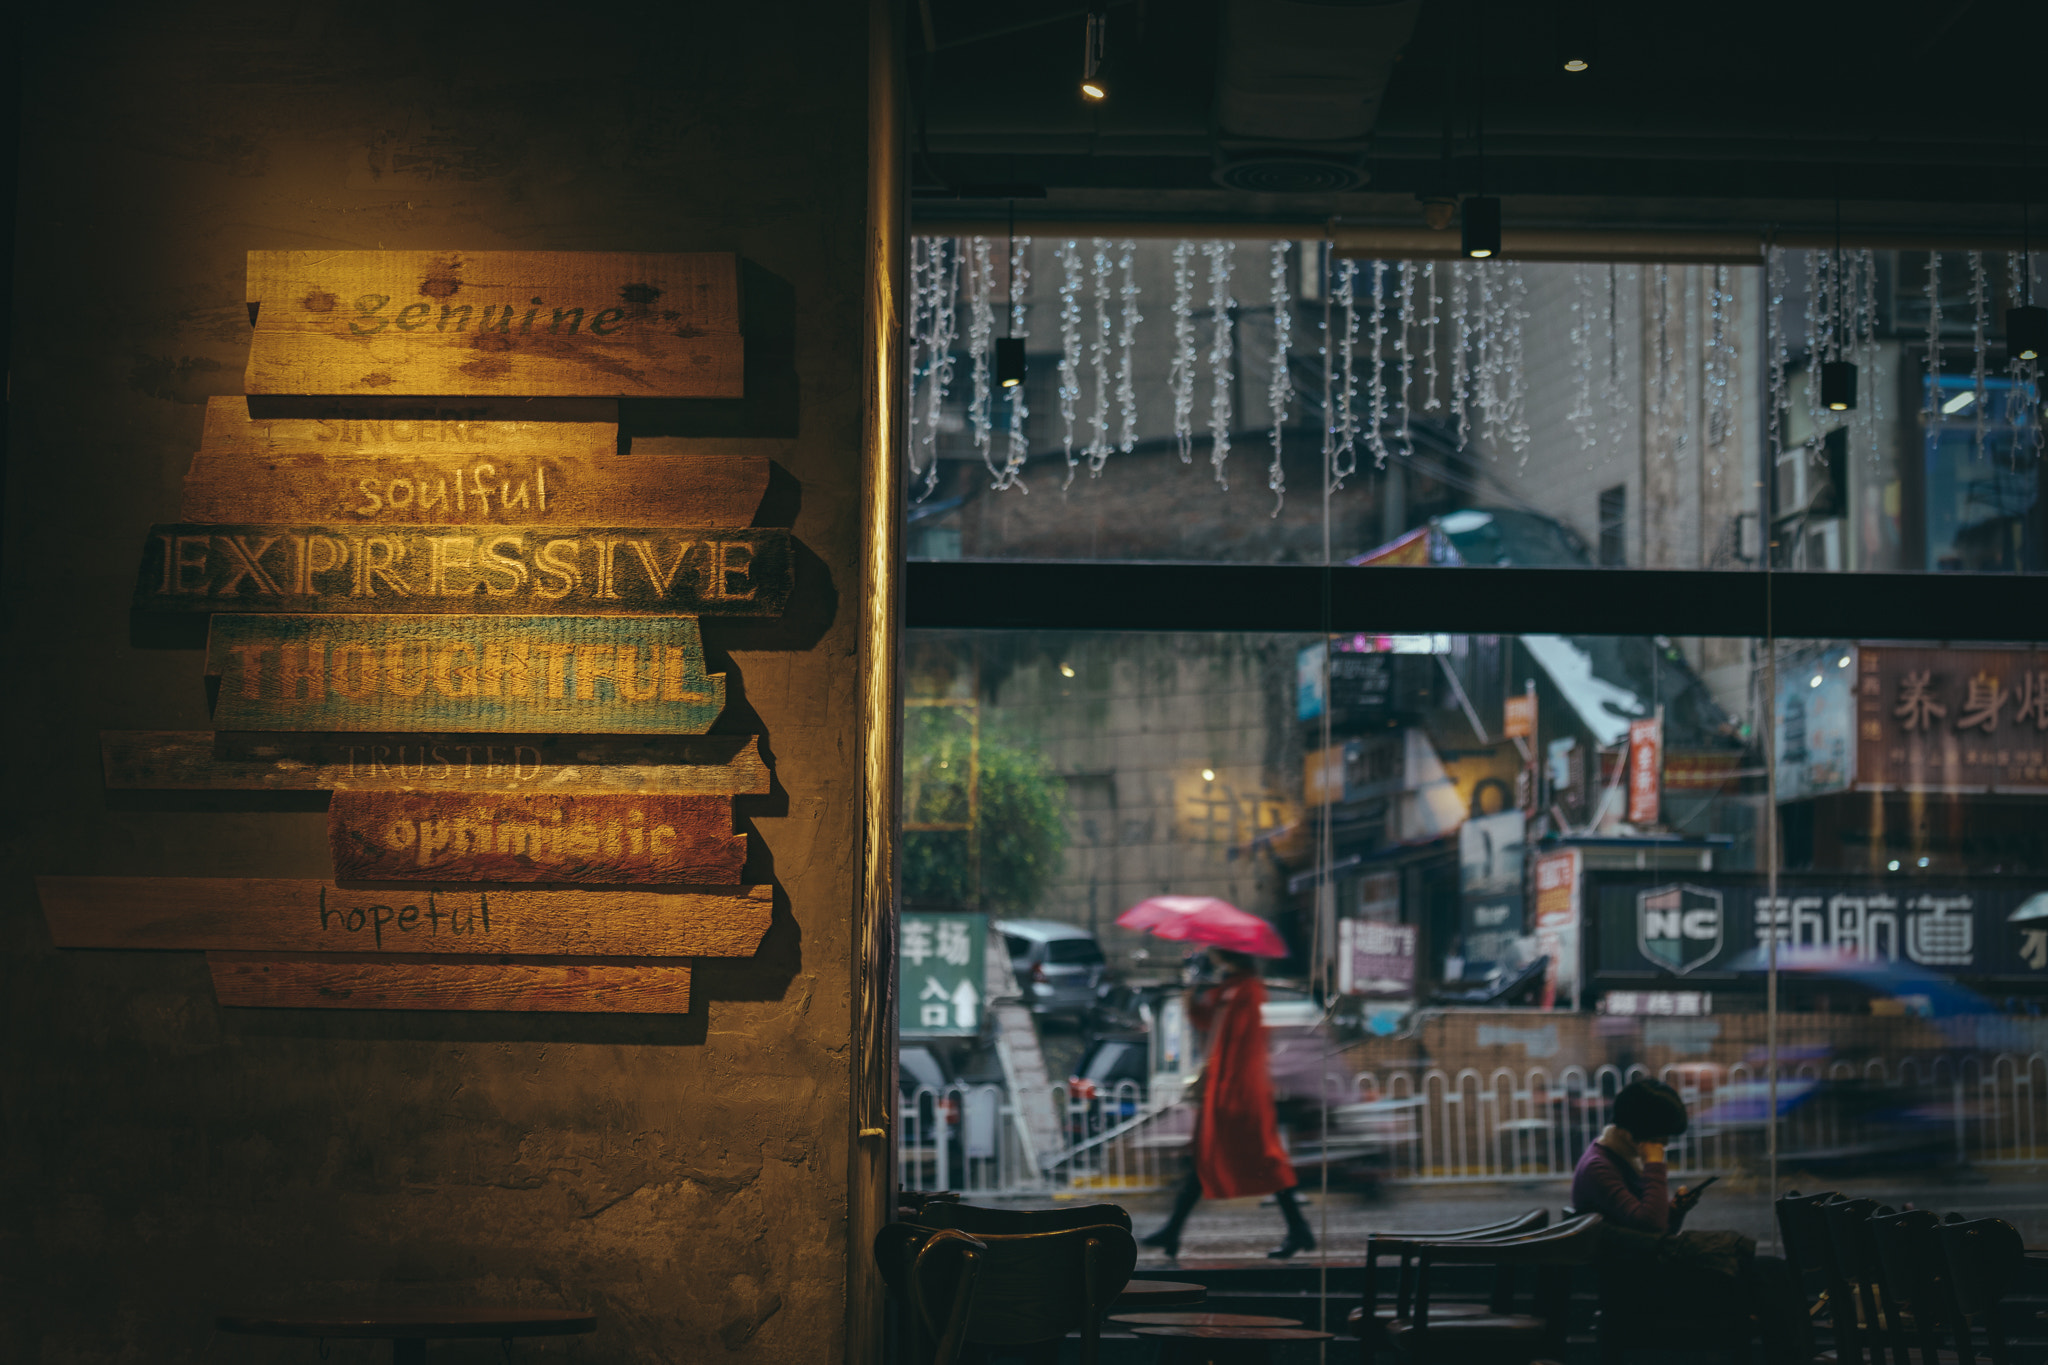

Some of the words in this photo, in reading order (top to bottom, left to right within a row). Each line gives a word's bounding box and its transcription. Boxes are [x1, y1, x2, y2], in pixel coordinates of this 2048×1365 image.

[349, 293, 627, 337] genuine
[316, 406, 492, 445] SINCERE
[347, 463, 549, 516] soulful
[155, 532, 759, 602] EXPRESSIVE
[227, 640, 717, 702] THOUGHTFUL
[338, 743, 543, 781] TRUSTED
[385, 807, 678, 866] optimistic
[319, 886, 491, 949] hopeful
[1645, 908, 1719, 941] NC
[918, 974, 950, 1027] 入口
